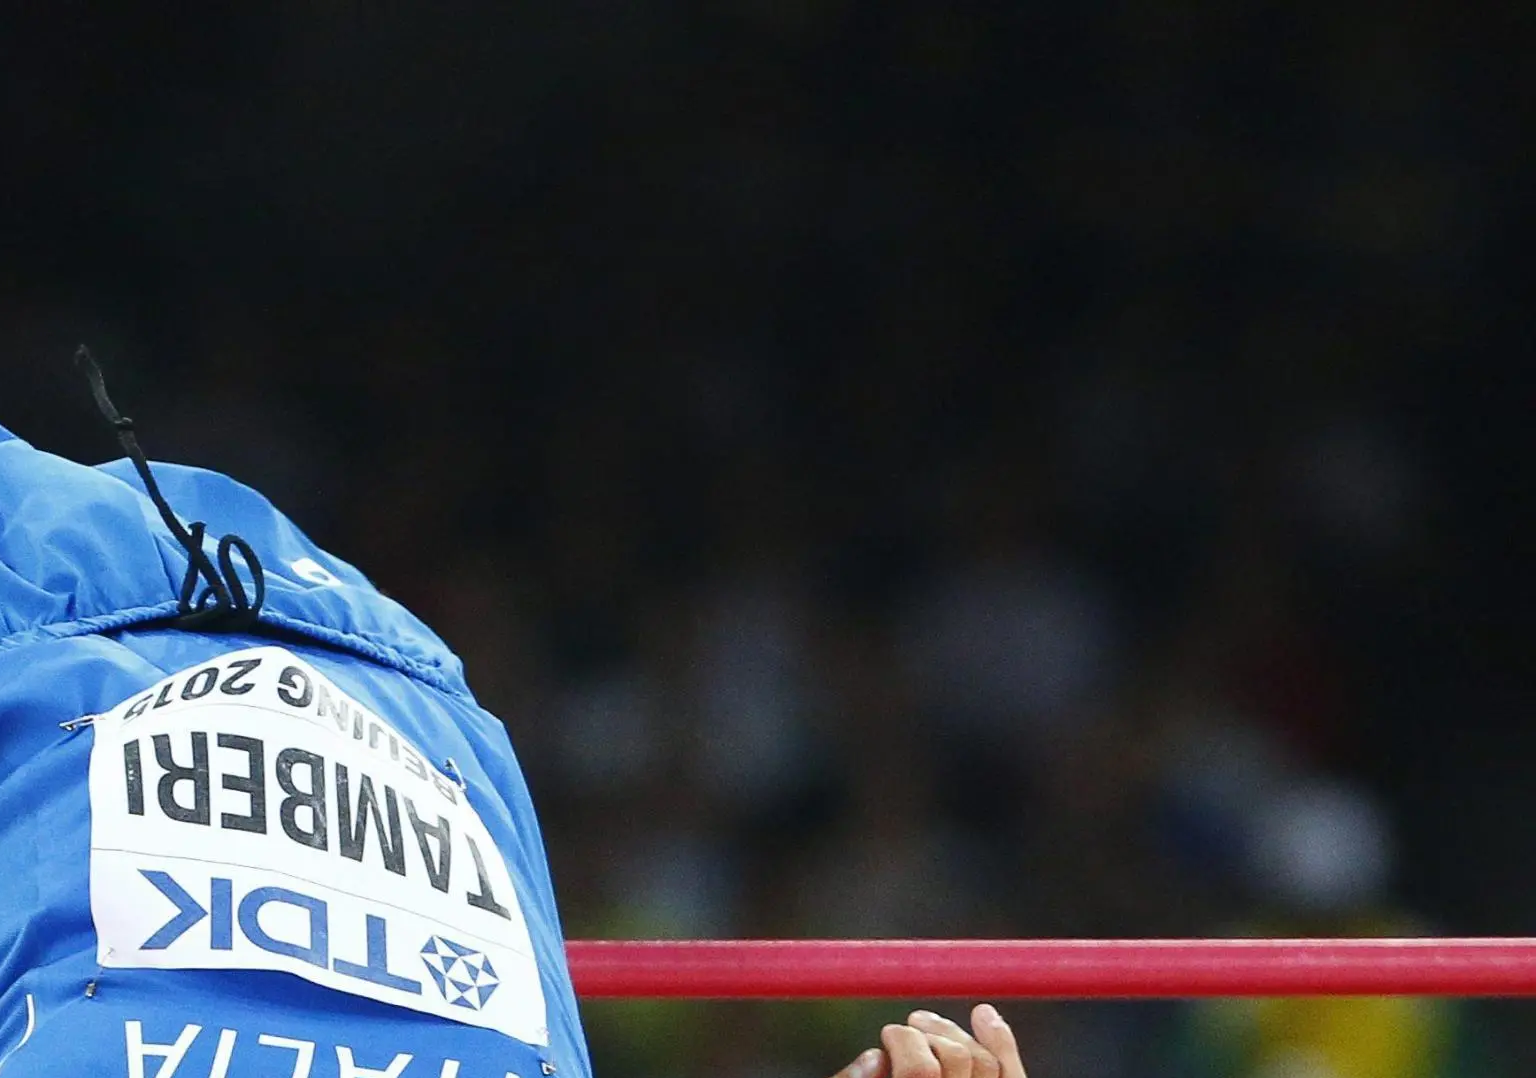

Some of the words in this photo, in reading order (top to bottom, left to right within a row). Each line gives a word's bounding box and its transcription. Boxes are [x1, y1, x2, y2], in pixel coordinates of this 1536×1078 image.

[124, 658, 262, 720] 2015
[277, 664, 458, 805] BEIJING
[124, 731, 511, 920] TAMBERI
[137, 869, 421, 995] TDK
